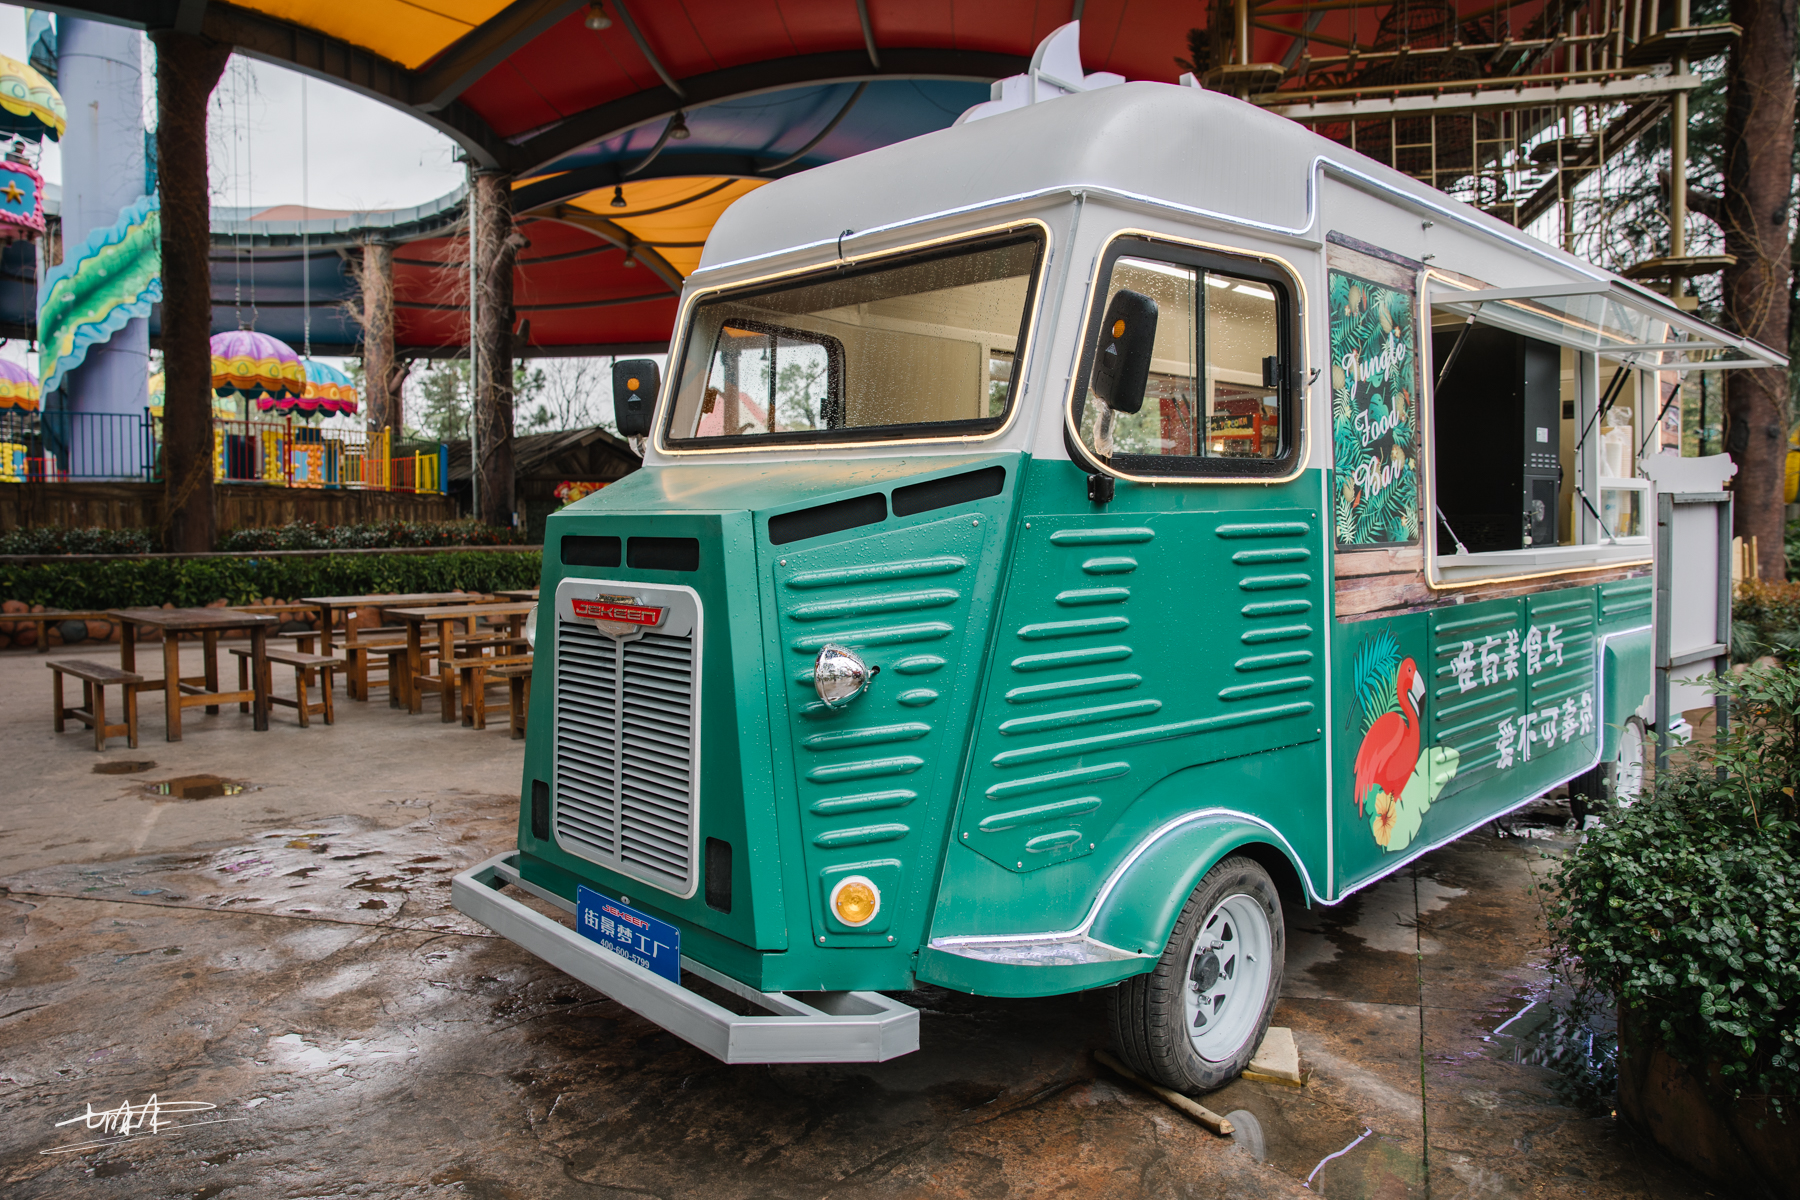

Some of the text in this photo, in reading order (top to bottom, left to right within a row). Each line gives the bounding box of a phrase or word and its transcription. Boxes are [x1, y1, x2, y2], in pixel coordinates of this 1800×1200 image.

[1341, 332, 1406, 400] Jungle
[1355, 396, 1400, 447] Food
[1354, 455, 1401, 500] Bar
[584, 908, 670, 958] 街景梦工厂
